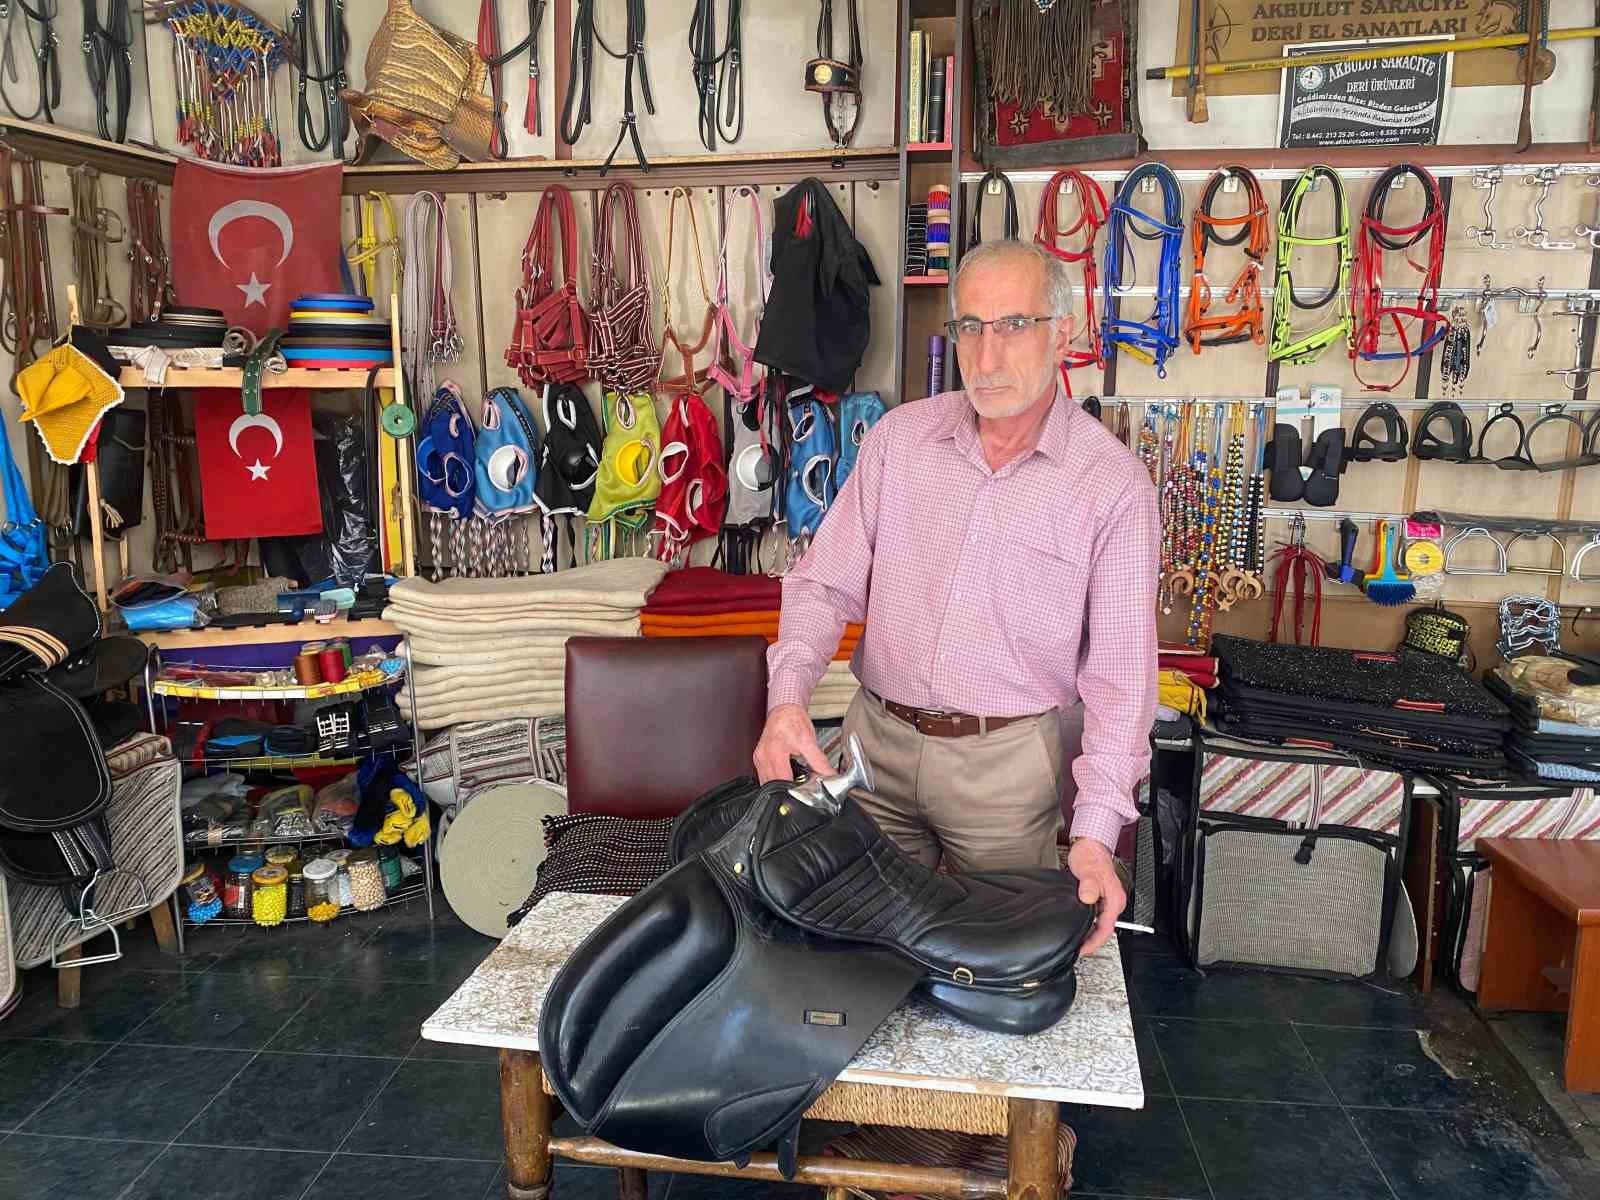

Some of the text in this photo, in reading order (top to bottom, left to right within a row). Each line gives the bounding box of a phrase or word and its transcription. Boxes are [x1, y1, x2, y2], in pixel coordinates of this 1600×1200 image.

[1253, 1, 1354, 19] AKBULUT
[1252, 18, 1467, 41] DERİ EL SANATLARI
[1346, 79, 1368, 93] DERİ
